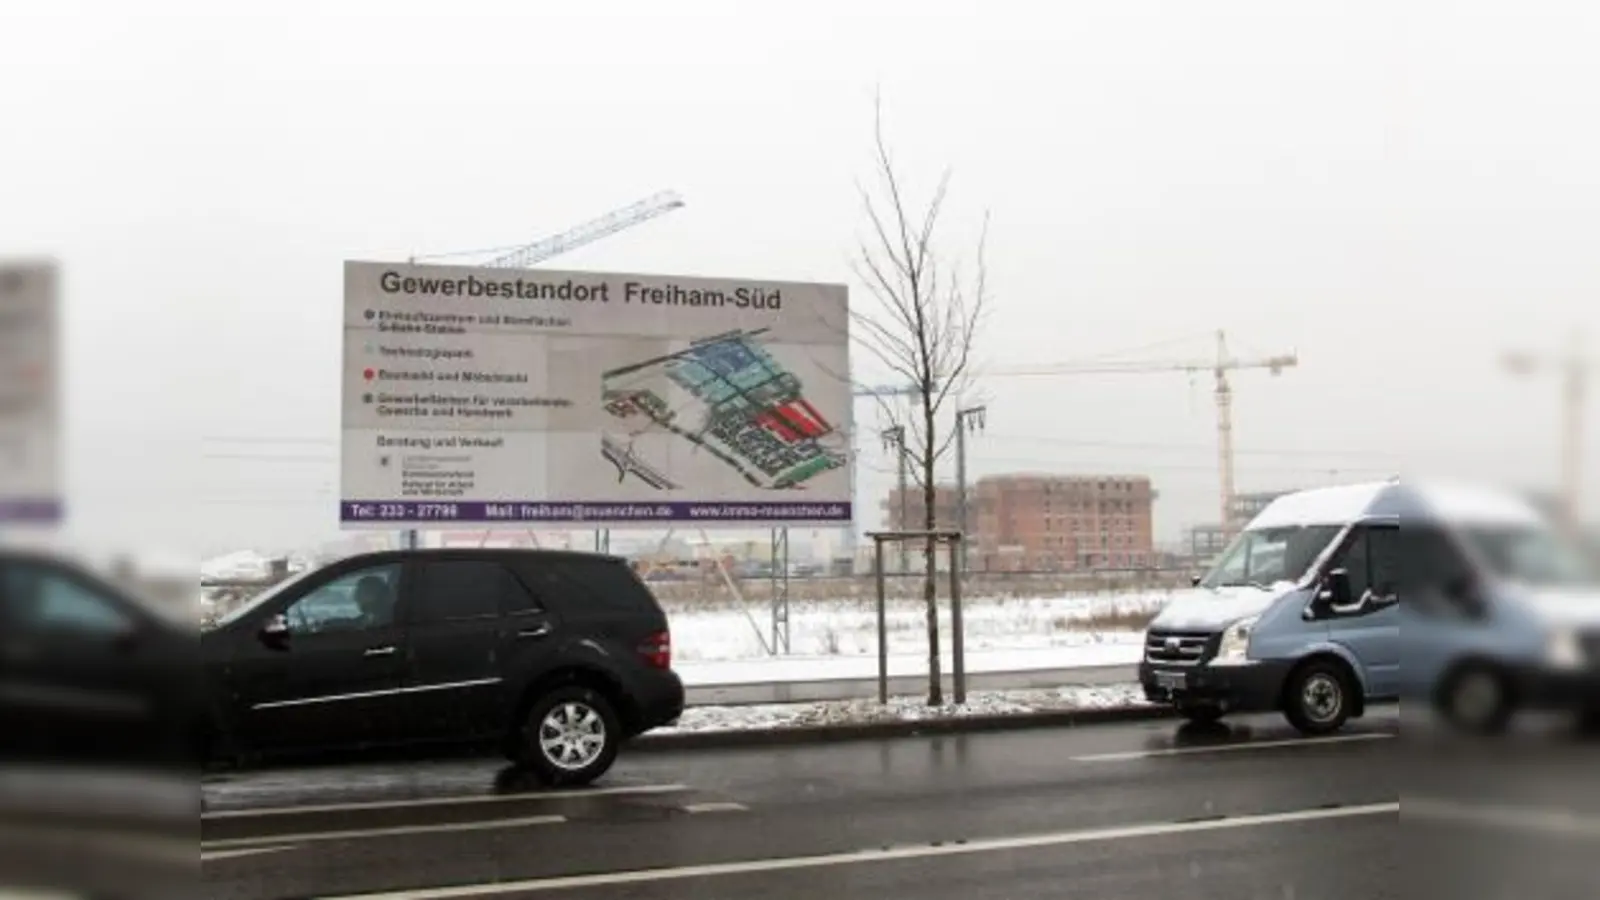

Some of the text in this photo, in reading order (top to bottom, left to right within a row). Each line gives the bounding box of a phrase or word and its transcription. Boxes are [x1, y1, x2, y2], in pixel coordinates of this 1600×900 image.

[380, 271, 782, 310] Gewerbestandort Freiham-Süd
[437, 370, 459, 382] und
[432, 407, 454, 417] und
[376, 435, 430, 449] Beratung
[434, 436, 456, 448] und
[350, 504, 375, 517] Tel:
[379, 504, 404, 517] 233
[689, 505, 844, 518] www.immo-muenchen.de
